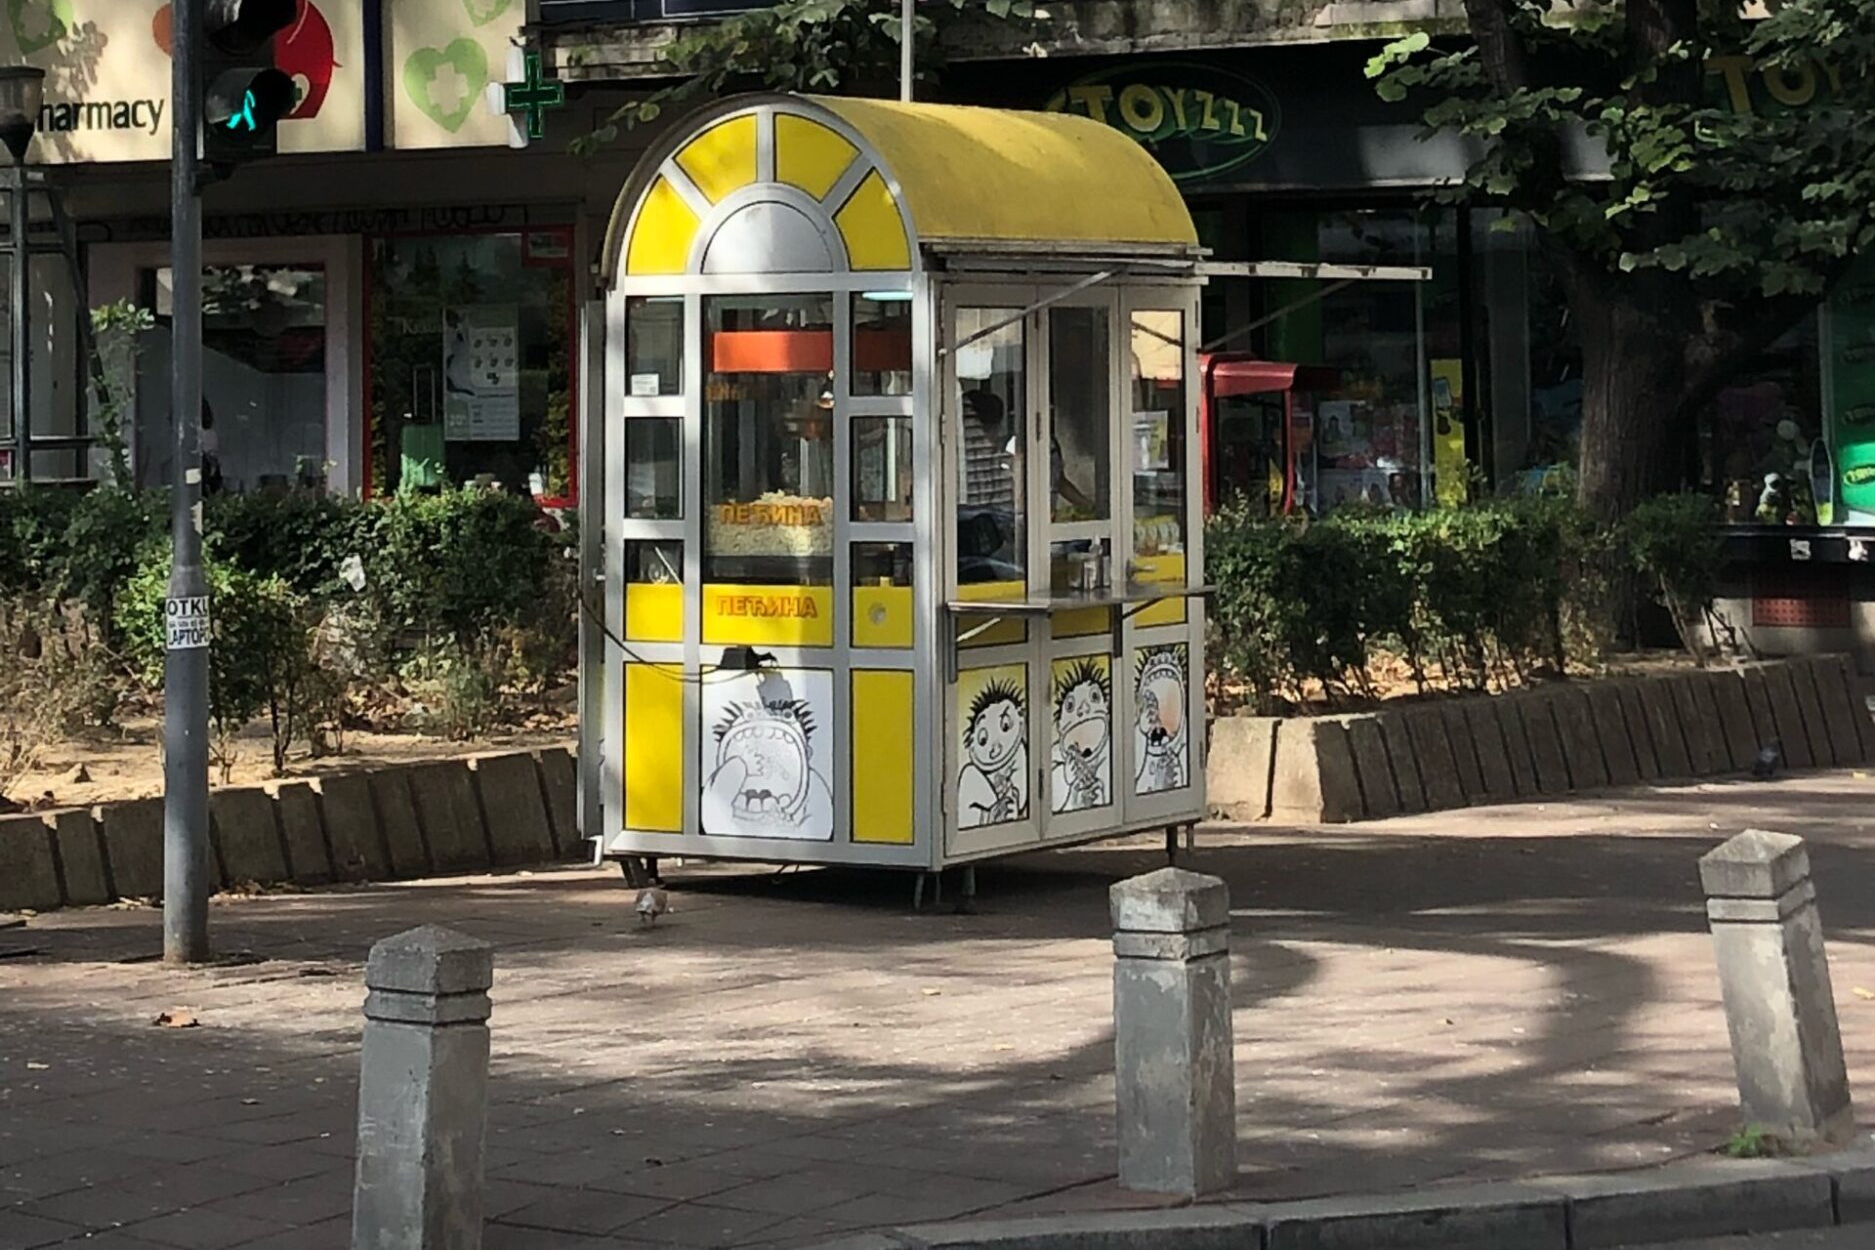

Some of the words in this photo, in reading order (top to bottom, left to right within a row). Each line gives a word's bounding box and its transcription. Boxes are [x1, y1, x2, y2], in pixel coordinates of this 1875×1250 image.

[37, 99, 165, 136] harmacy
[1067, 82, 1268, 143] TOYZZZ
[715, 594, 819, 619] ПЕЋИНА
